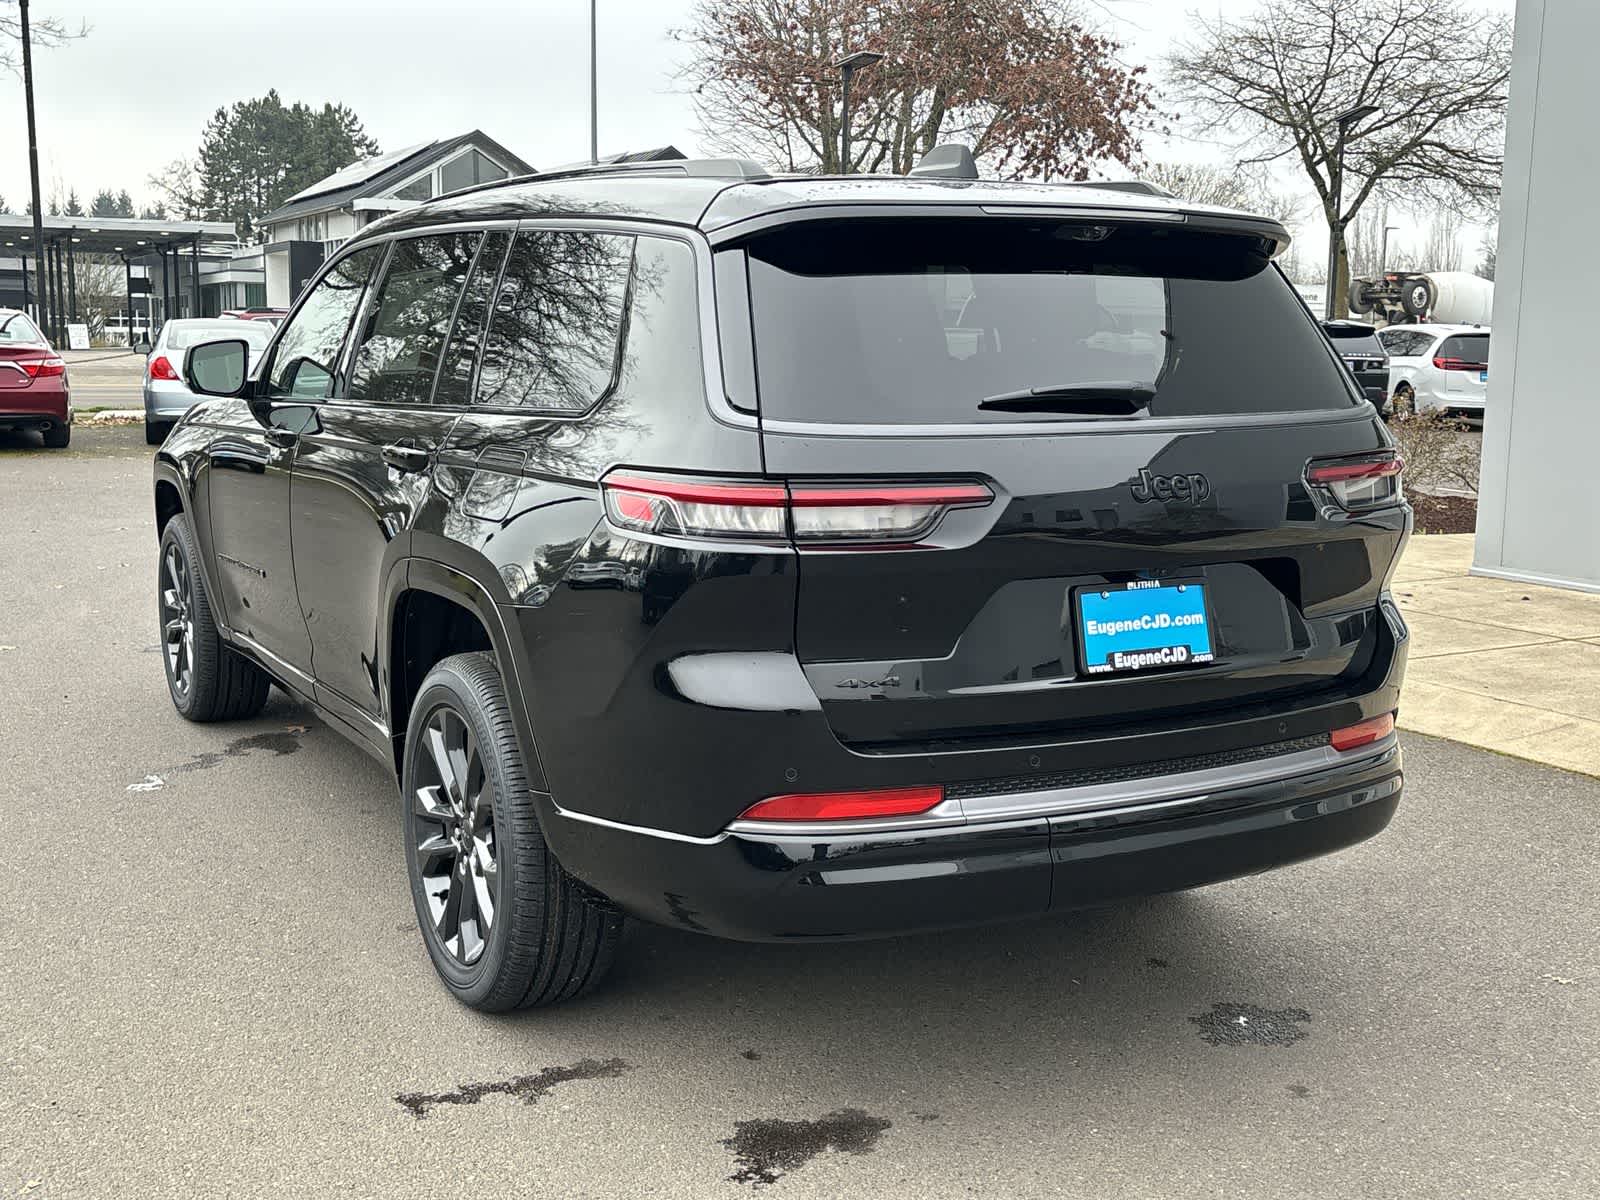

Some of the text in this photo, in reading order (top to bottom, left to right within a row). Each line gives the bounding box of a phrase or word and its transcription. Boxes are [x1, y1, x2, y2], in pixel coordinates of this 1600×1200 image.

[1130, 468, 1210, 507] Jeep
[1086, 613, 1204, 636] EugeneCJD.com
[1114, 646, 1187, 669] EugeneCJD
[1191, 653, 1214, 663] .com
